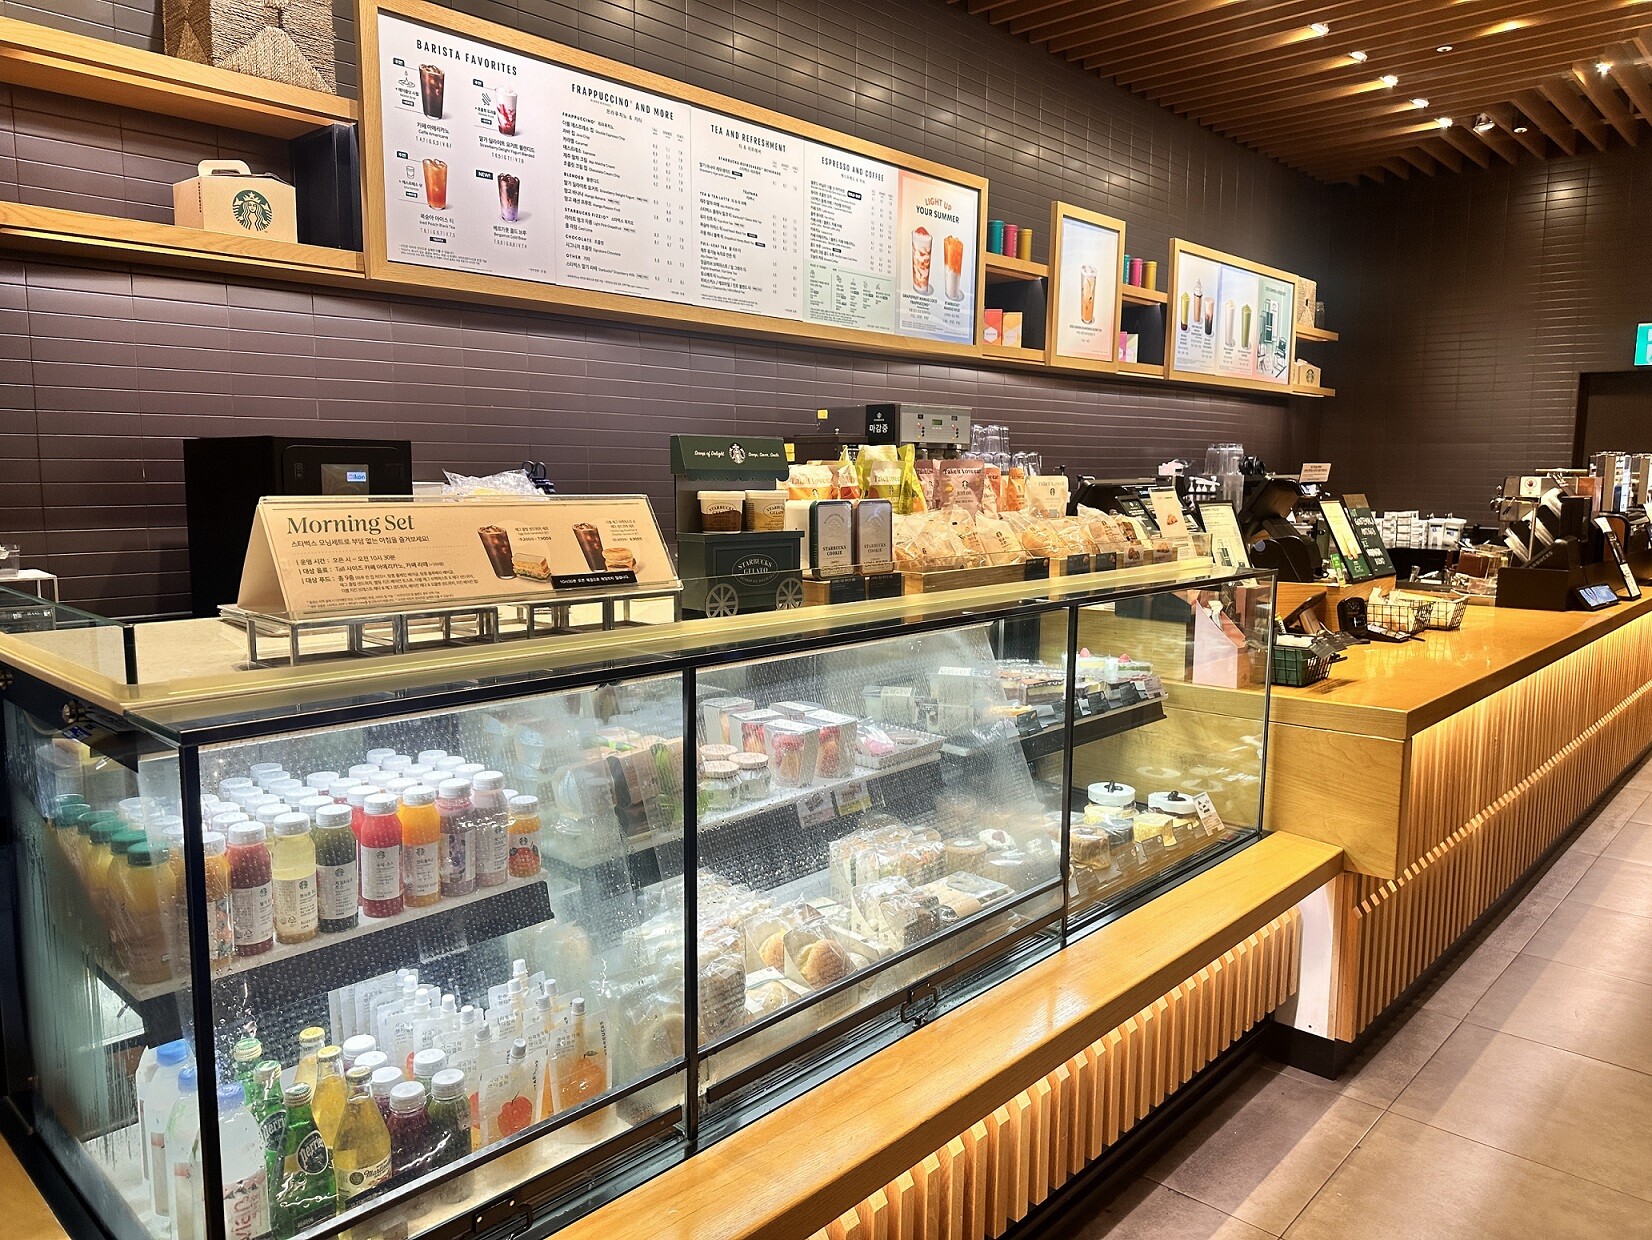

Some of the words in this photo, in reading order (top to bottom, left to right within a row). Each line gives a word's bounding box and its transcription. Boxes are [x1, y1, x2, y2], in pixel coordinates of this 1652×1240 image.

[416, 39, 460, 60] BARISTA
[465, 53, 517, 76] FAVORITES
[635, 102, 650, 113] AND
[654, 107, 673, 120] MORE
[711, 124, 723, 134] TEA
[726, 129, 739, 139] AND
[742, 134, 786, 152] REFRESHMENT
[822, 157, 850, 172] ESPRESSO
[852, 166, 863, 175] AND
[865, 170, 884, 182] COFFEE
[925, 197, 942, 208] LIGHT
[944, 202, 952, 211] UP
[916, 205, 933, 218] YOUR
[934, 212, 960, 224] SUMMER
[869, 424, 888, 433] 마감중
[287, 515, 382, 535] Morning
[385, 514, 415, 531] Set
[738, 559, 772, 570] STARBUCKS
[261, 1116, 285, 1142] Perri
